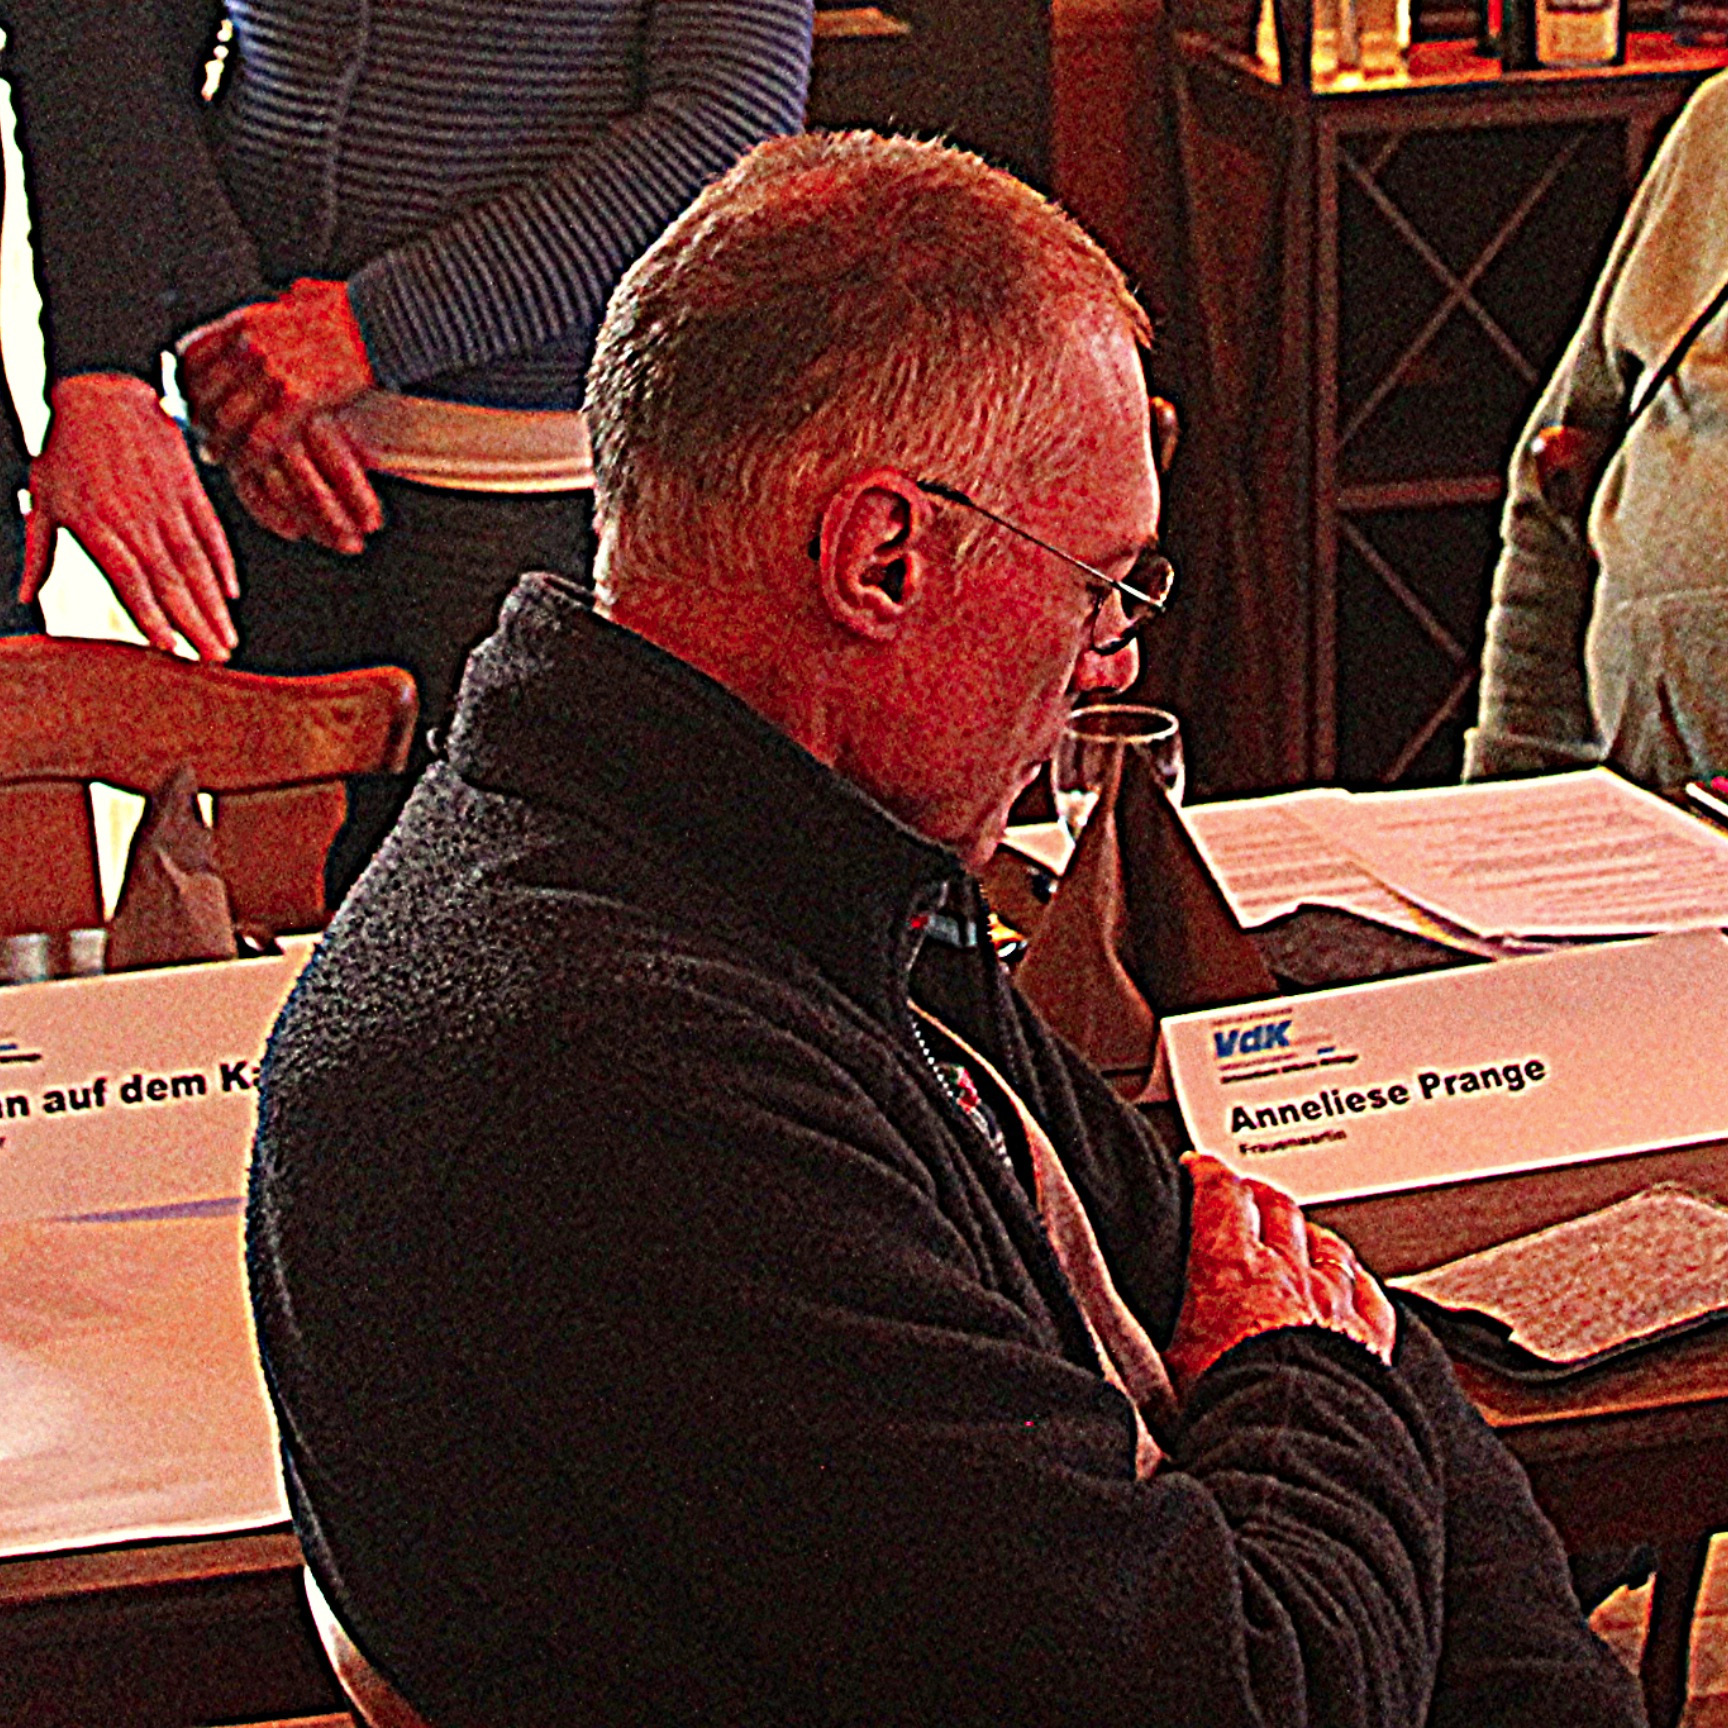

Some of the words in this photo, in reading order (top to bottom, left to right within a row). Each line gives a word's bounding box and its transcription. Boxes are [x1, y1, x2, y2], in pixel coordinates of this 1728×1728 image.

[1213, 1019, 1293, 1059] VdK
[42, 1077, 108, 1114] auf
[120, 1074, 207, 1104] dem
[1231, 1085, 1410, 1133] Anneliese
[1418, 1059, 1547, 1100] Prange
